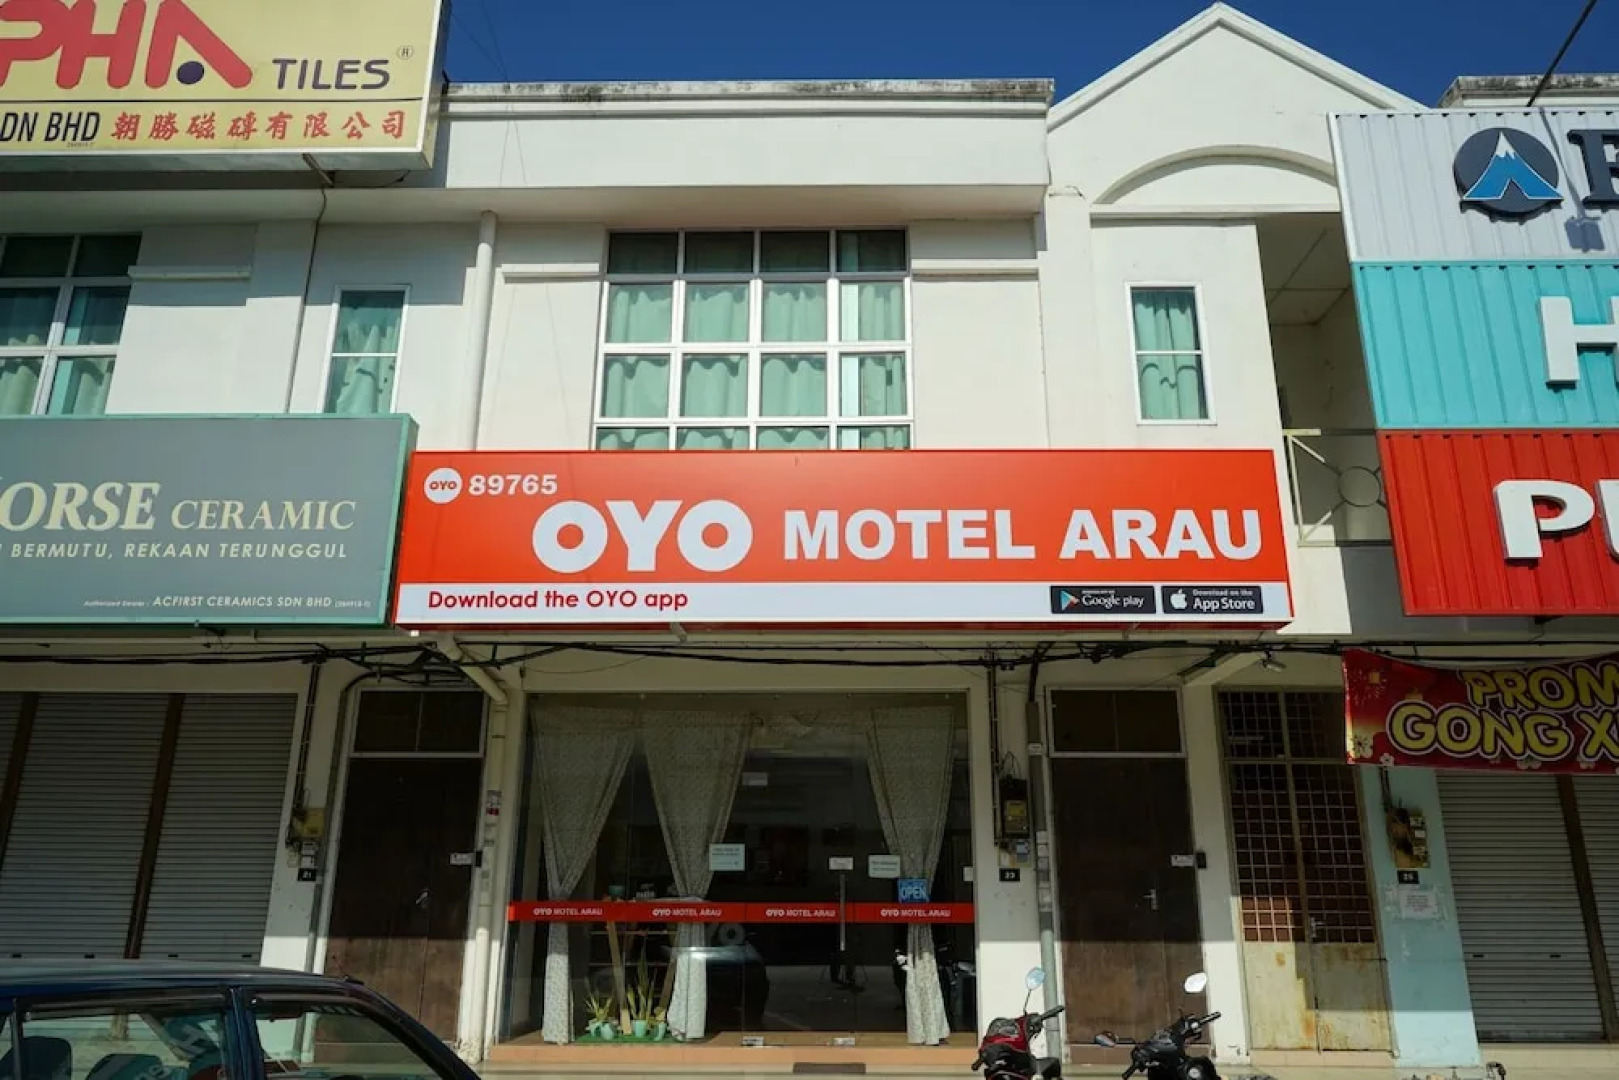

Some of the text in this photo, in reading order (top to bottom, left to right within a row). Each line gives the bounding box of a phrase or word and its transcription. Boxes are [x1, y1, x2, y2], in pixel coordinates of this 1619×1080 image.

[272, 58, 390, 90] TILES
[45, 111, 100, 142] BHD
[429, 473, 557, 495] OYO 89765
[0, 479, 356, 531] ORSE CERAMIC
[532, 500, 1262, 574] OYO MOTEL ARAU
[11, 543, 347, 560] BERMUTU, REKAAN TERUNGGUL
[428, 590, 688, 611] Download the OYO app
[1193, 588, 1228, 597] Download
[207, 596, 273, 607] CERAMICS
[276, 596, 302, 607] SDN
[306, 596, 331, 607] BHD
[1082, 594, 1145, 609] Google play
[1193, 597, 1256, 612] App Store
[1389, 702, 1571, 758] GONG
[902, 886, 926, 900] OPEN
[652, 908, 723, 916] OYO MOTEL ARAU
[765, 909, 836, 917] OYO MOTEL ARAU
[880, 909, 951, 917] OYO MOTEL ARAU
